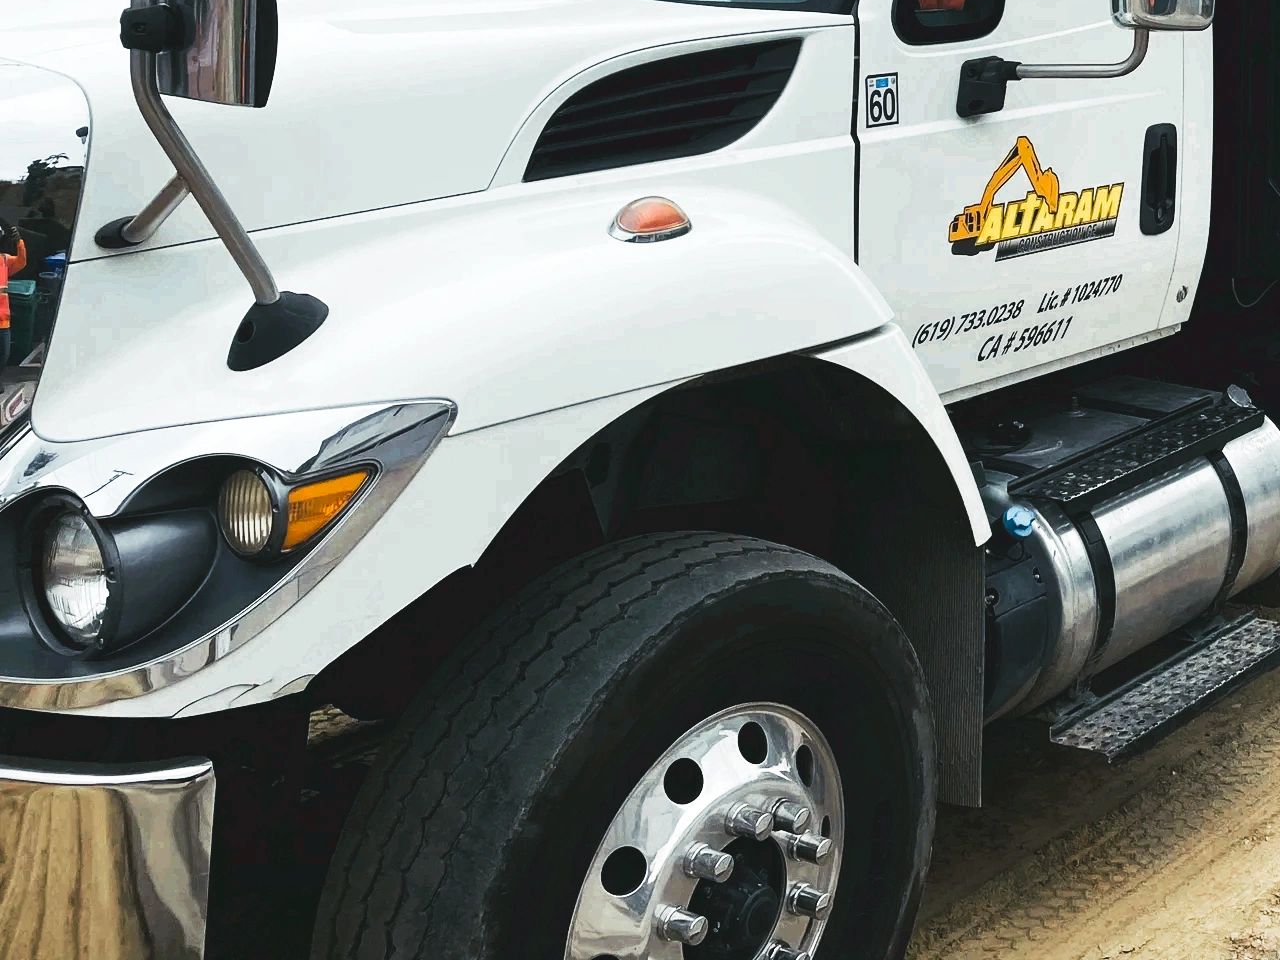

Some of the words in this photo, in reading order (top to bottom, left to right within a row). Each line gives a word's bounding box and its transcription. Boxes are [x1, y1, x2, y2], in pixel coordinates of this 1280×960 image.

[869, 87, 896, 123] 60
[975, 181, 1125, 247] ALTARAM
[1017, 227, 1085, 254] CONSTRUCTION
[911, 316, 956, 349] (619)
[954, 299, 1025, 335] 733.0238
[1037, 290, 1059, 314] Lic.
[1059, 287, 1072, 308] #
[1071, 273, 1123, 305] 1024770
[977, 334, 1004, 362] CA
[1001, 330, 1018, 355] #
[1013, 315, 1074, 353] 596611
